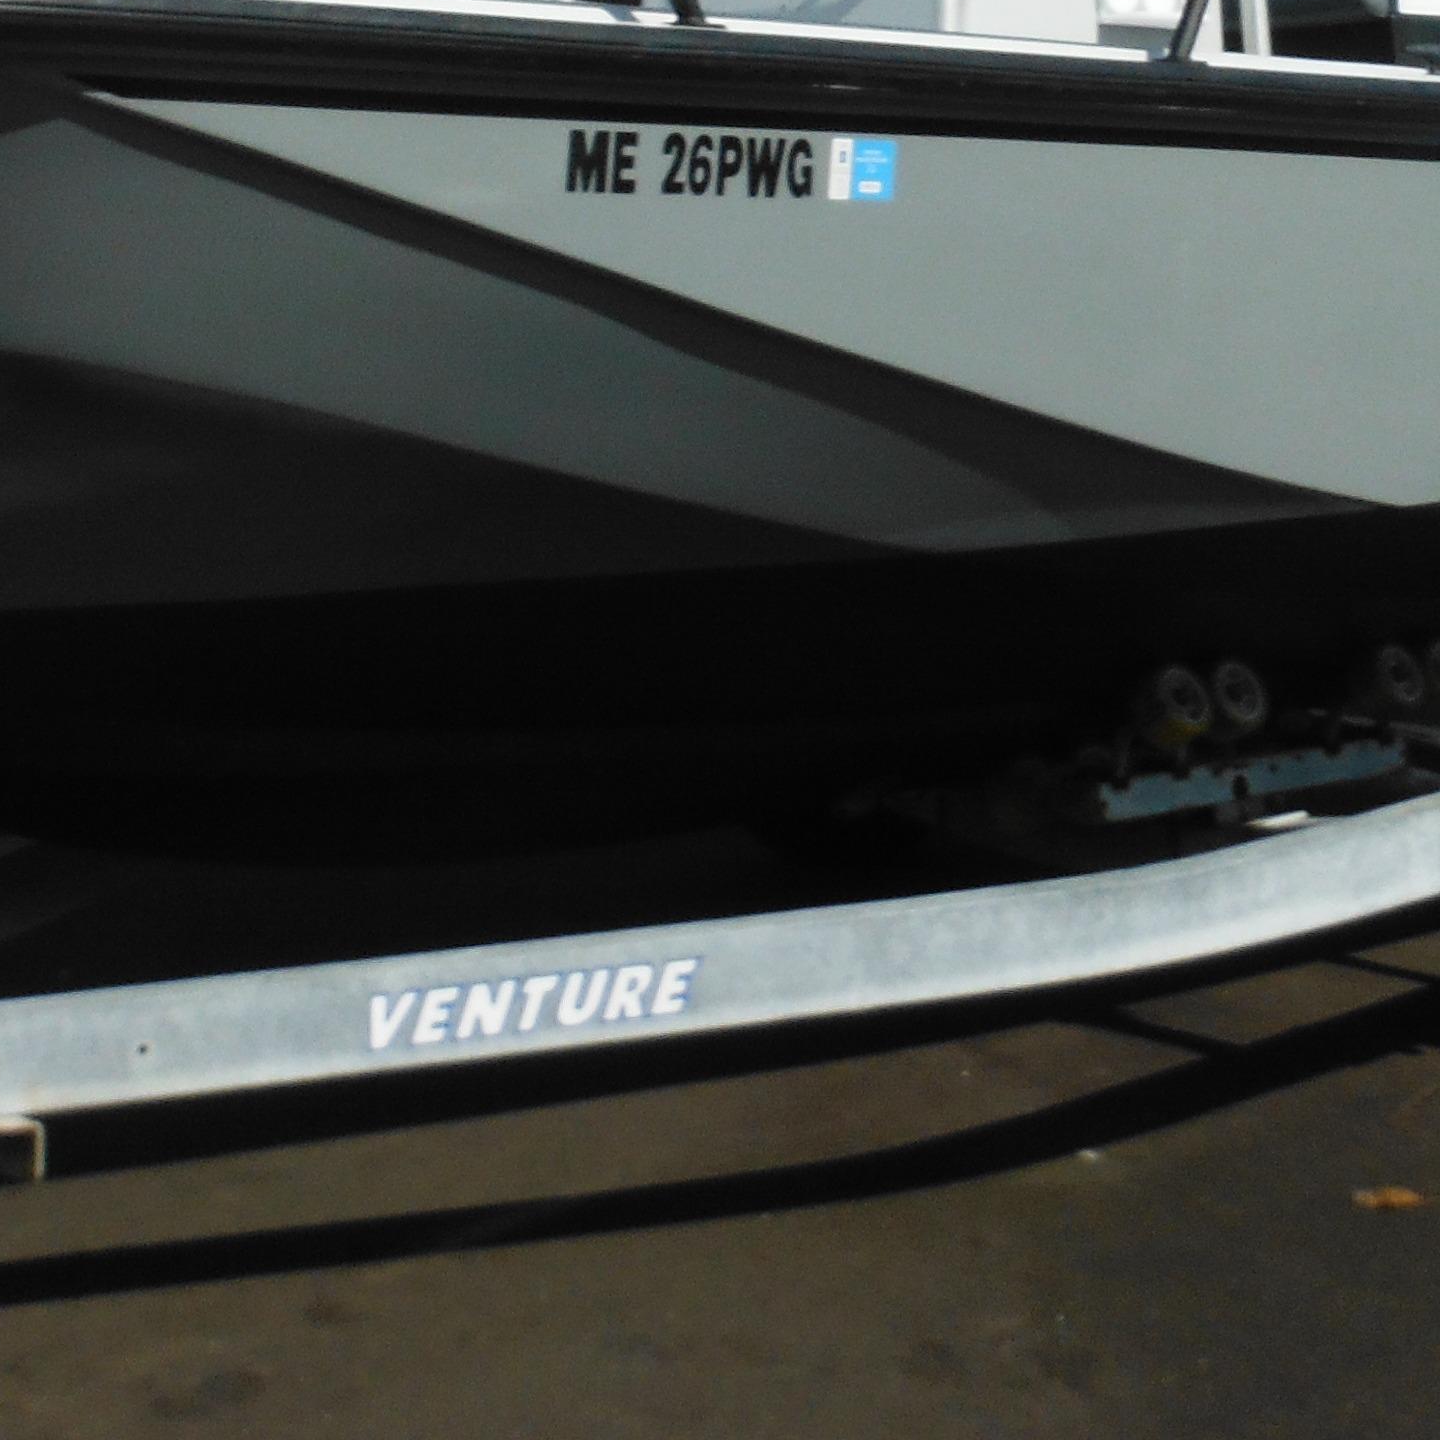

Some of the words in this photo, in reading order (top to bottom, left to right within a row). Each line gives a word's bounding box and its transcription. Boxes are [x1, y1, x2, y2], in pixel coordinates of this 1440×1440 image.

[565, 129, 639, 193] ME
[661, 132, 813, 198] 26PWG
[367, 957, 699, 1051] VENTURE
